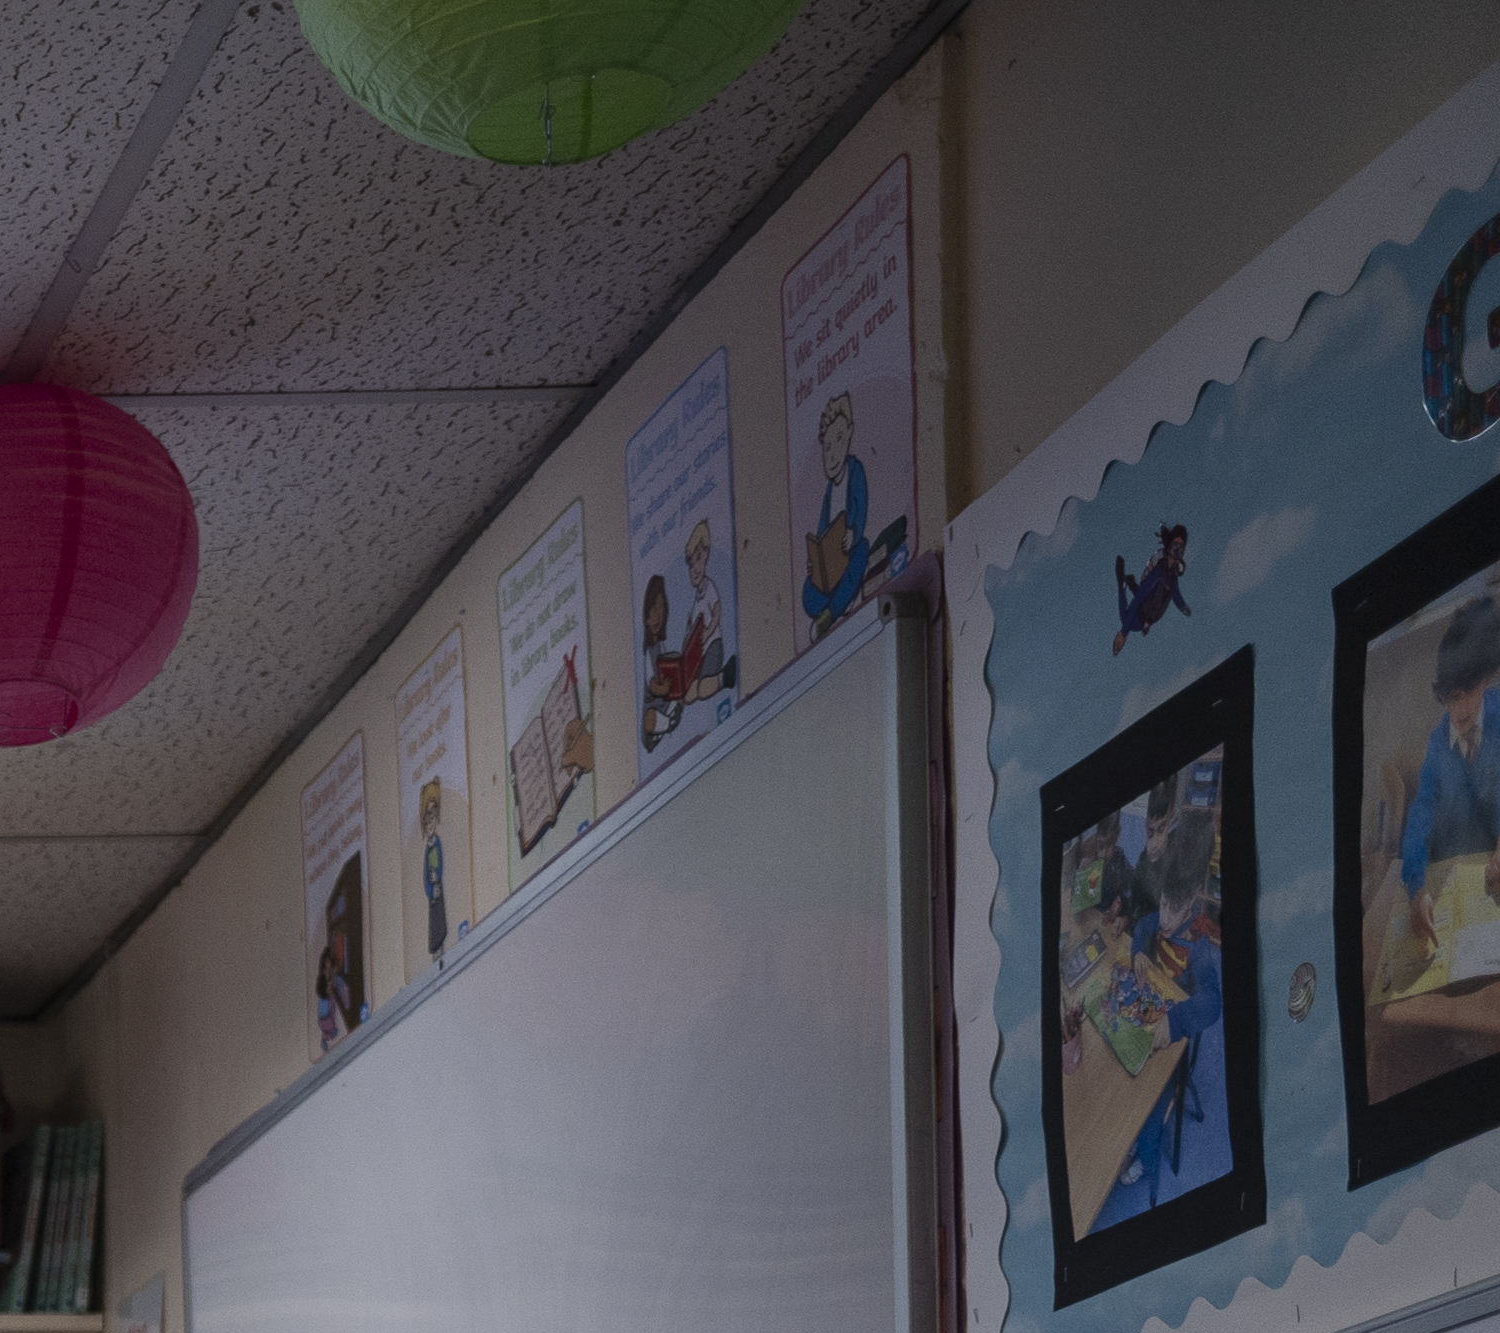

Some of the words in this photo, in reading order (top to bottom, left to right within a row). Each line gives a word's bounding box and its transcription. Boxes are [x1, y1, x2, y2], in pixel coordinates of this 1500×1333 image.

[787, 242, 850, 319] Library
[854, 184, 901, 253] Rules
[794, 342, 813, 371] We
[816, 320, 831, 347] sit
[835, 277, 880, 336] quietly
[883, 254, 898, 280] in
[794, 378, 813, 408] the
[817, 333, 860, 385] library
[864, 302, 898, 339] area.
[630, 417, 680, 483] Library
[682, 375, 721, 428] Rules
[646, 485, 672, 519] share
[674, 465, 692, 491] our
[693, 431, 726, 473] stories
[502, 556, 544, 613] Library
[547, 524, 579, 564] Rules
[640, 526, 659, 558] with
[661, 510, 679, 537] our
[521, 640, 550, 677] library
